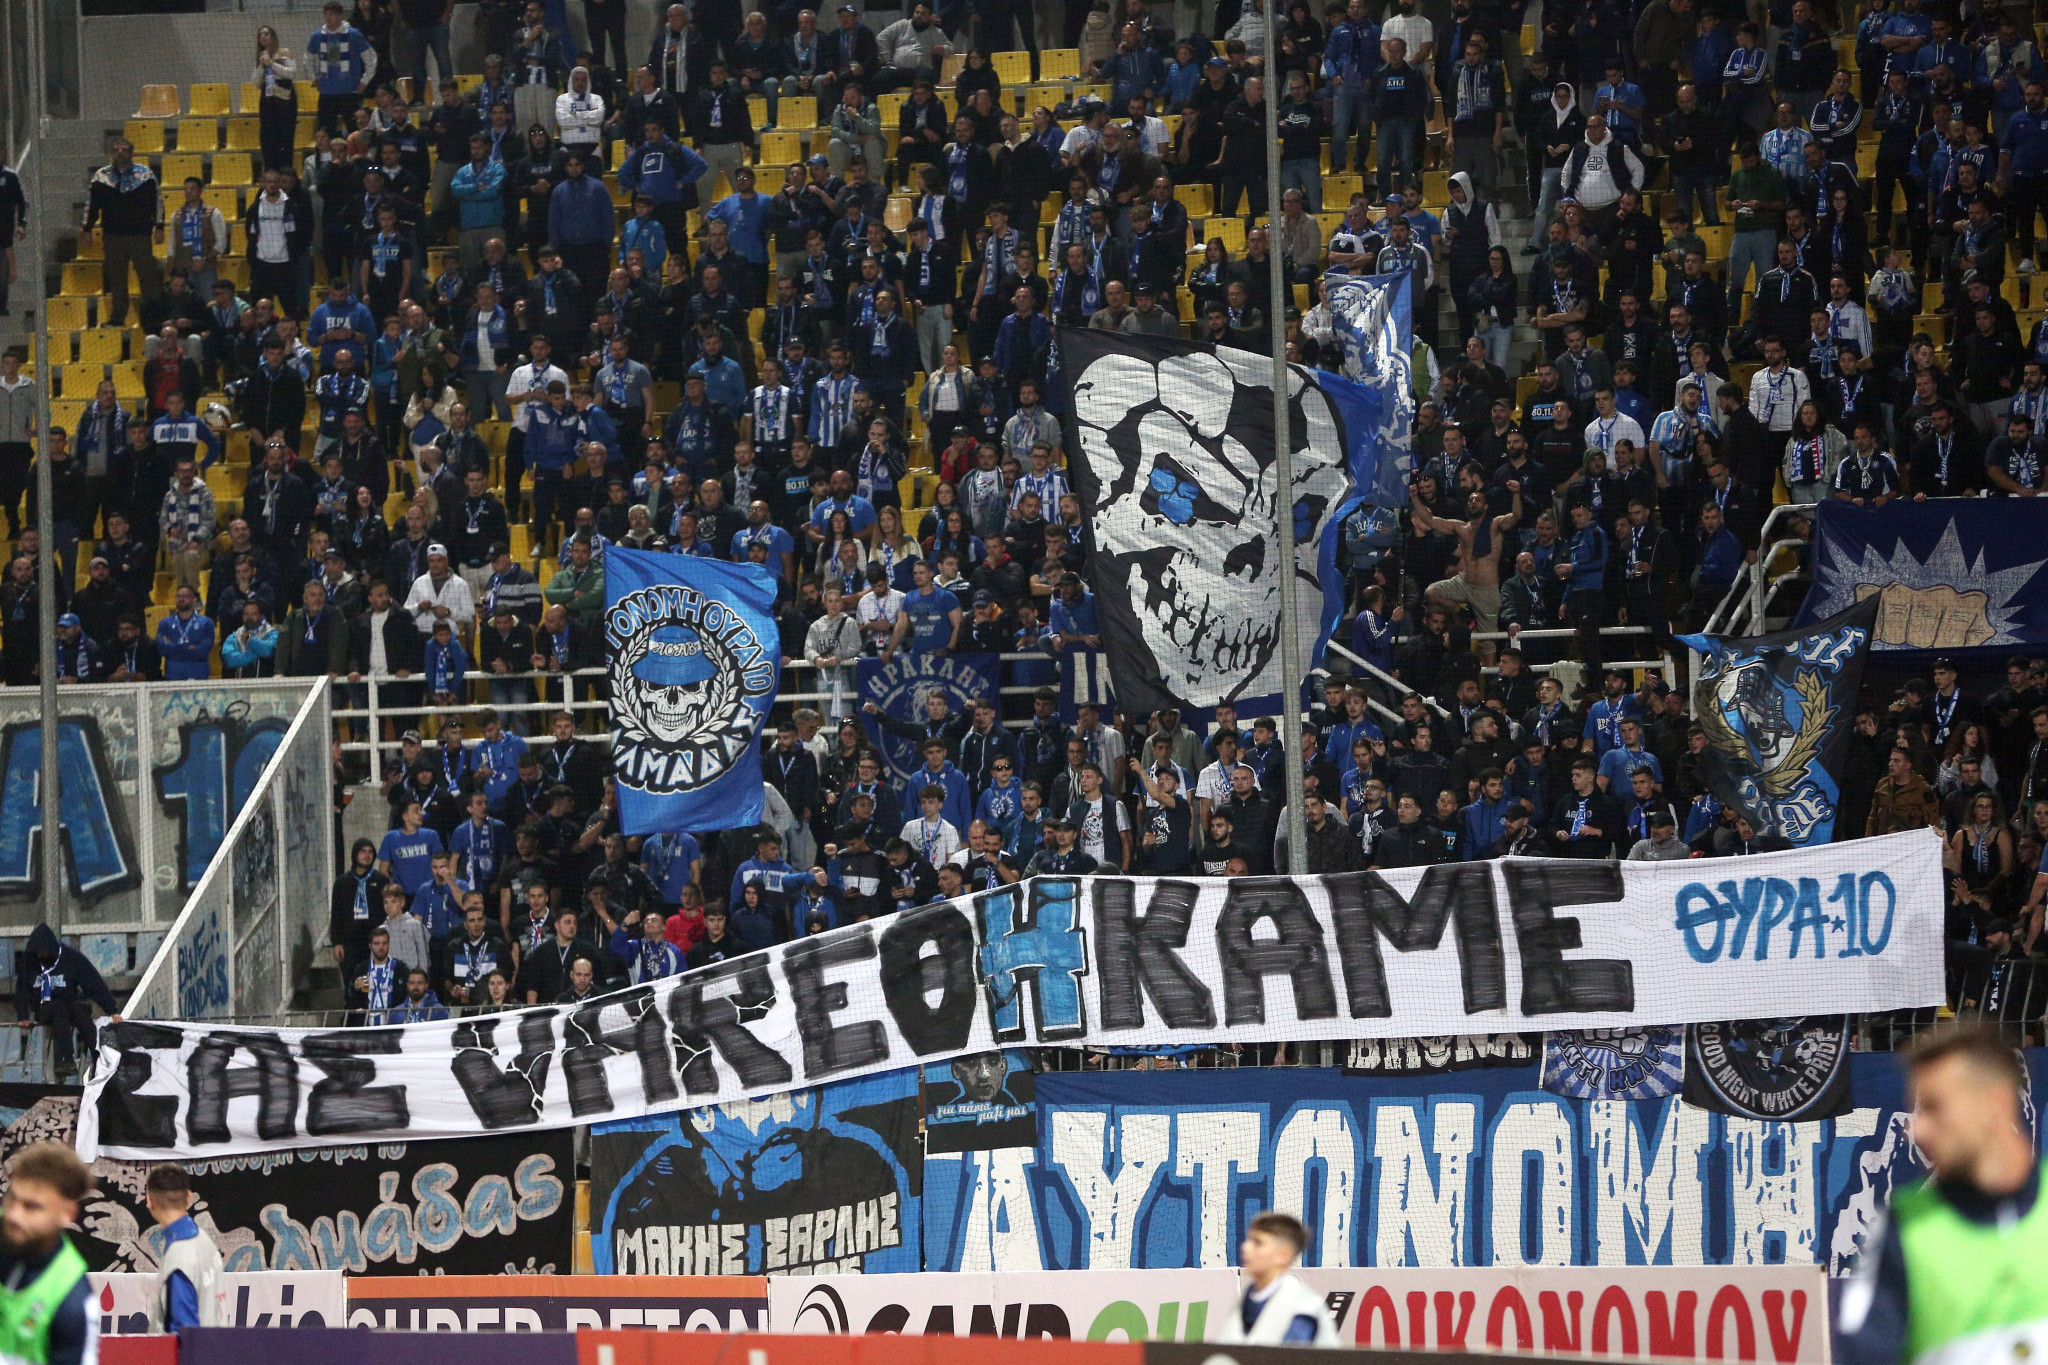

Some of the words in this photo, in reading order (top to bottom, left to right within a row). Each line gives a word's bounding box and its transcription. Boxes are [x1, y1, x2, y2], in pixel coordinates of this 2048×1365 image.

[1700, 1022, 1727, 1069] GOOD
[1716, 1064, 1759, 1108] NIGHT
[1761, 1076, 1815, 1112] WHITE
[1804, 1031, 1841, 1084] PRIDE
[616, 1223, 746, 1276] ΜΑΚΗΣ
